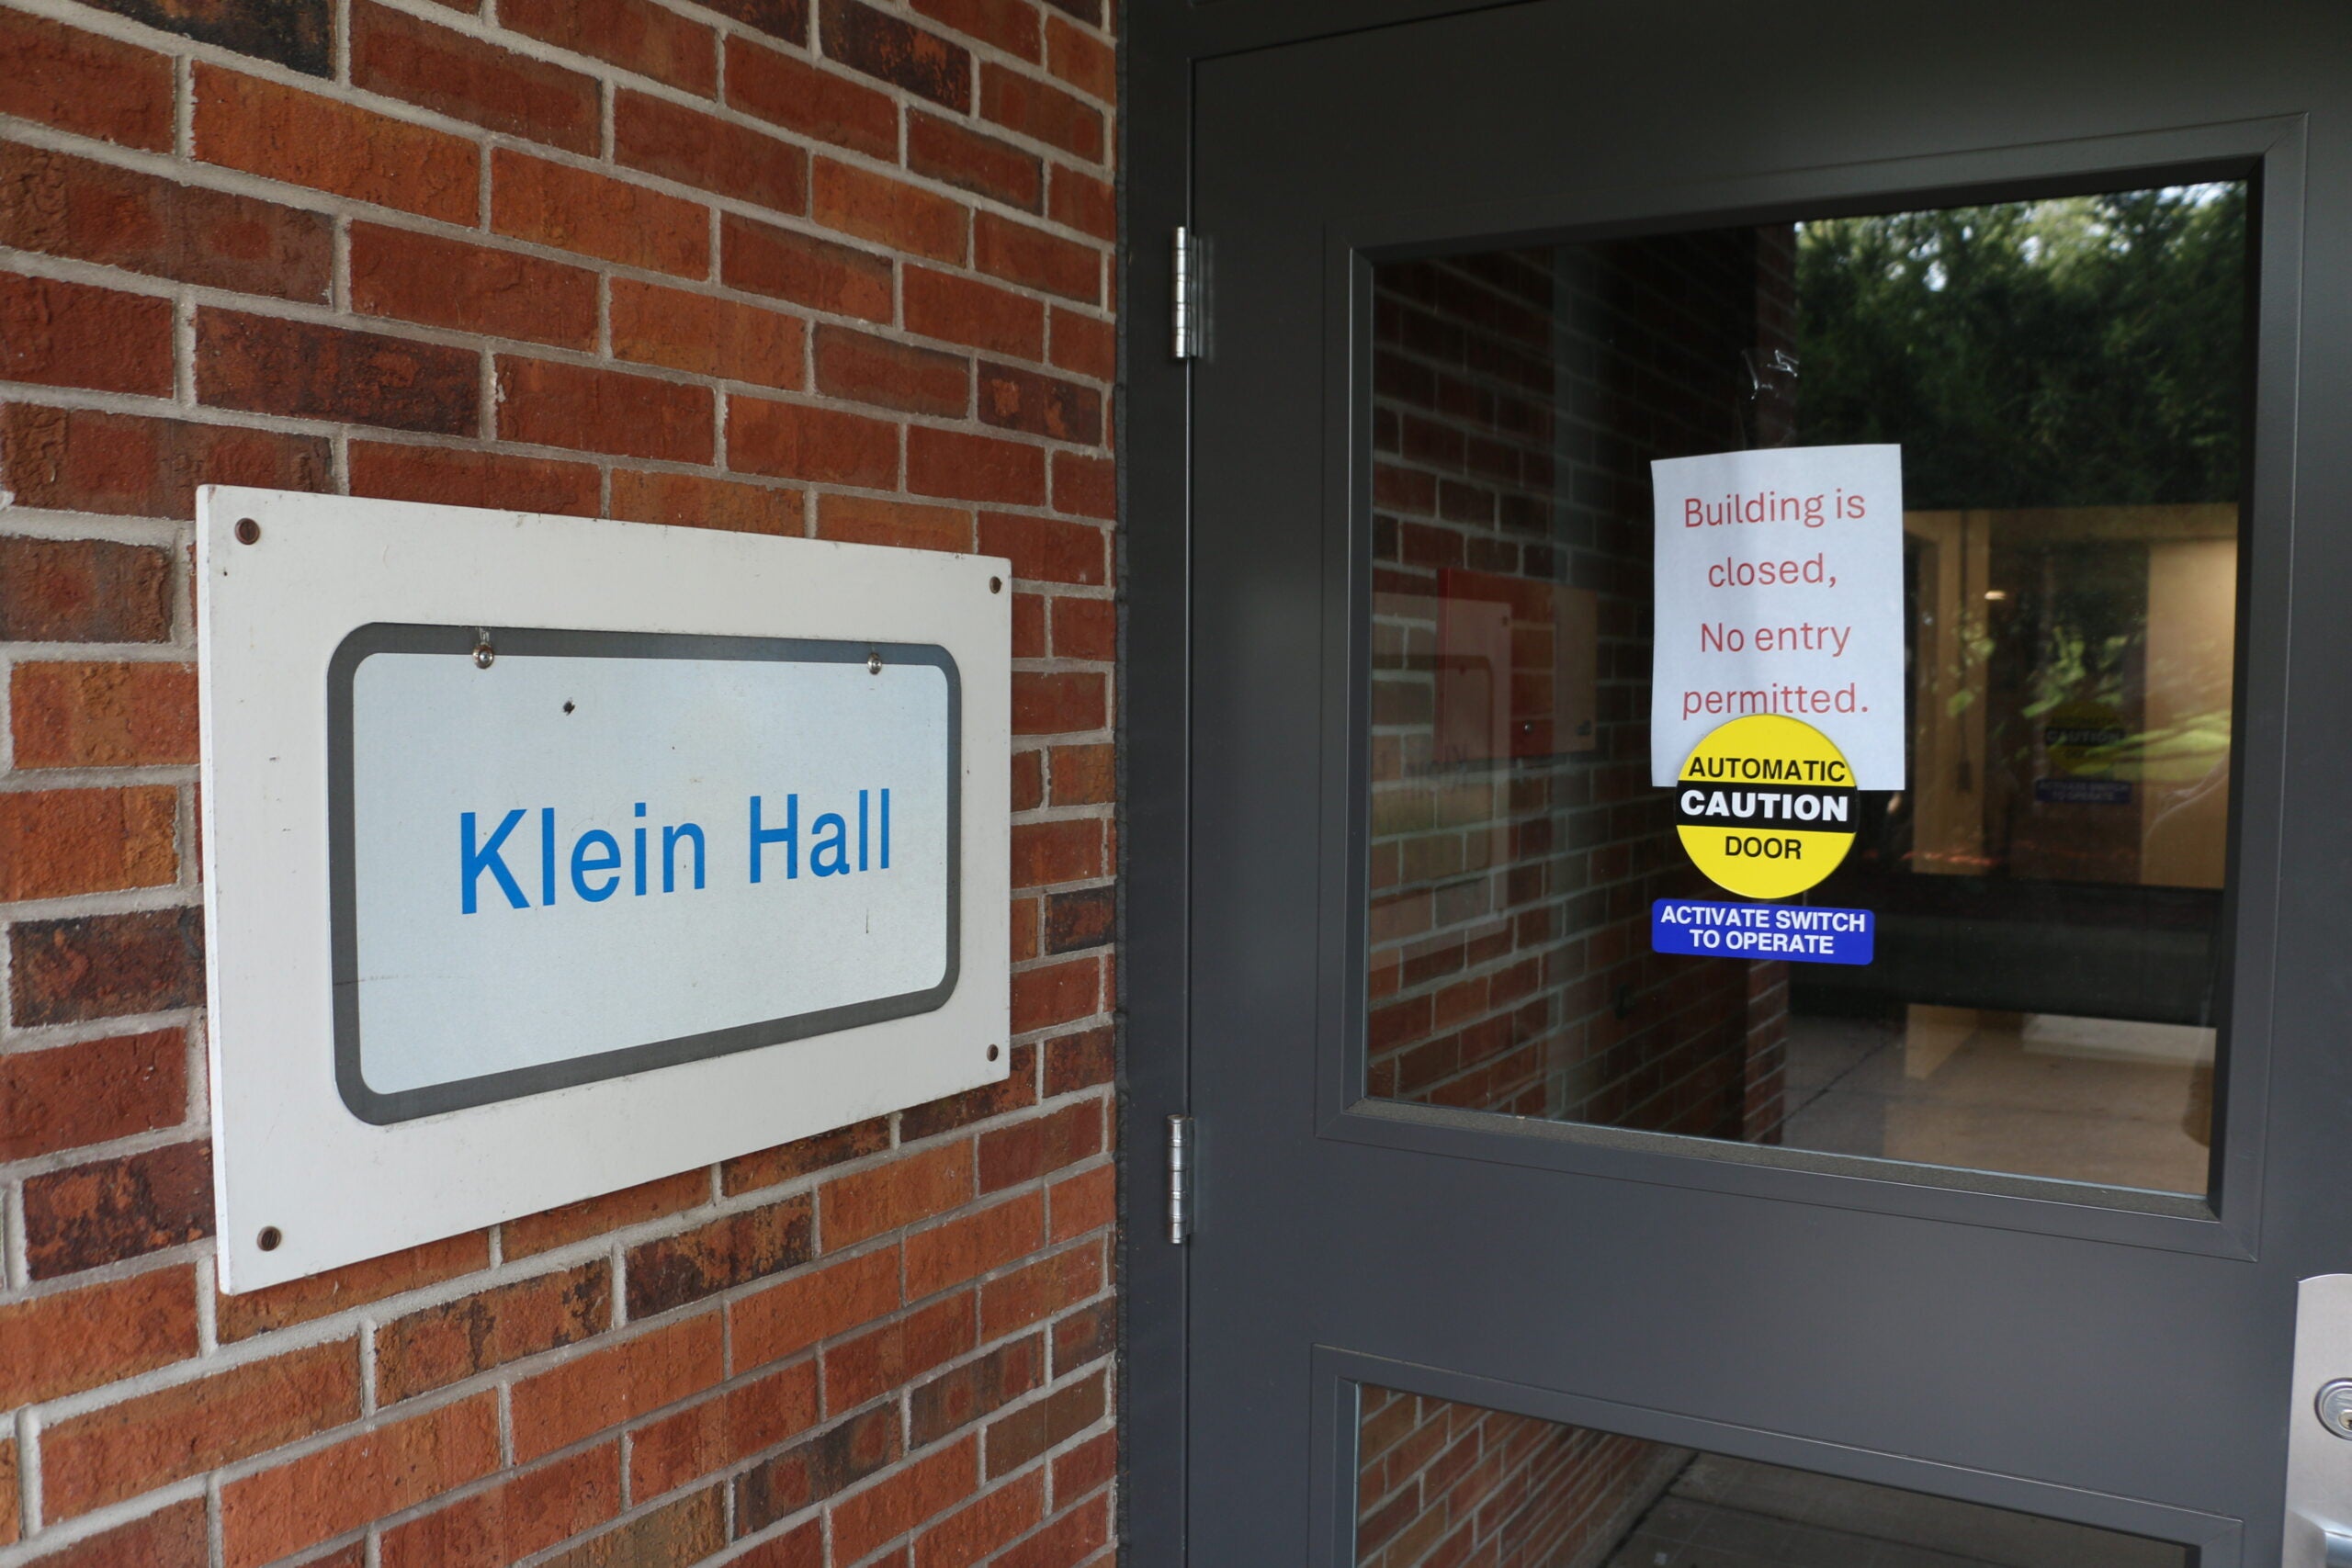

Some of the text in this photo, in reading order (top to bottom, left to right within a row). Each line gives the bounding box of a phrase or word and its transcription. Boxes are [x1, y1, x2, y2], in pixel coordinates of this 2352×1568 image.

[1684, 488, 1867, 528] Building is
[1708, 552, 1838, 588] closed,
[1701, 622, 1851, 658] No entry
[1681, 682, 1869, 721] permitted.
[1688, 756, 1846, 783] AUTOMATIC
[1679, 789, 1849, 822] CAUTION
[460, 787, 890, 916] Klein Hall
[1724, 835, 1803, 860] DOOR
[1660, 905, 1866, 933] ACTIVATE SWITCH
[1689, 929, 1835, 954] TO OPERATE
